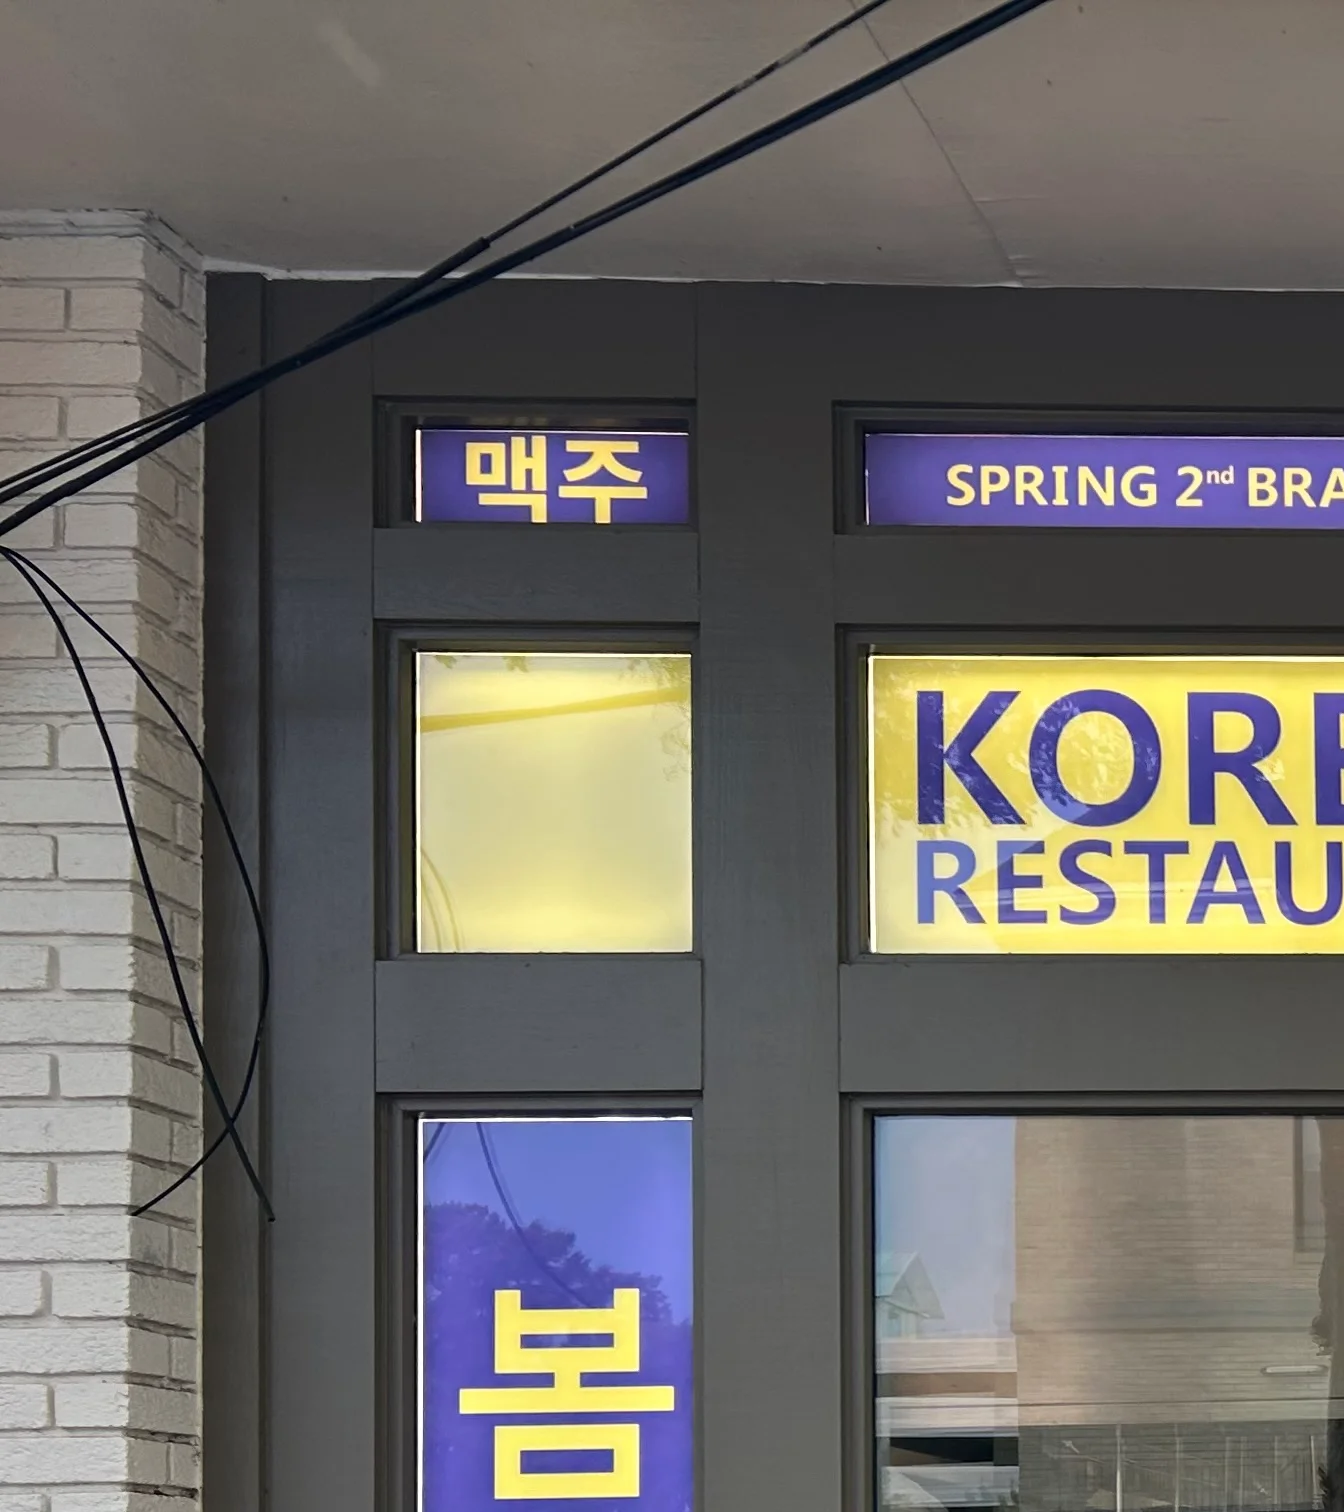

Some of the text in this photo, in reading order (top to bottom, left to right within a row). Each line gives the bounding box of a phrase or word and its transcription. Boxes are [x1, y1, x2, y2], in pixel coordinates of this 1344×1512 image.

[465, 436, 648, 524] 맥주
[944, 463, 1158, 509] SPRING
[1174, 465, 1235, 509] 2nd
